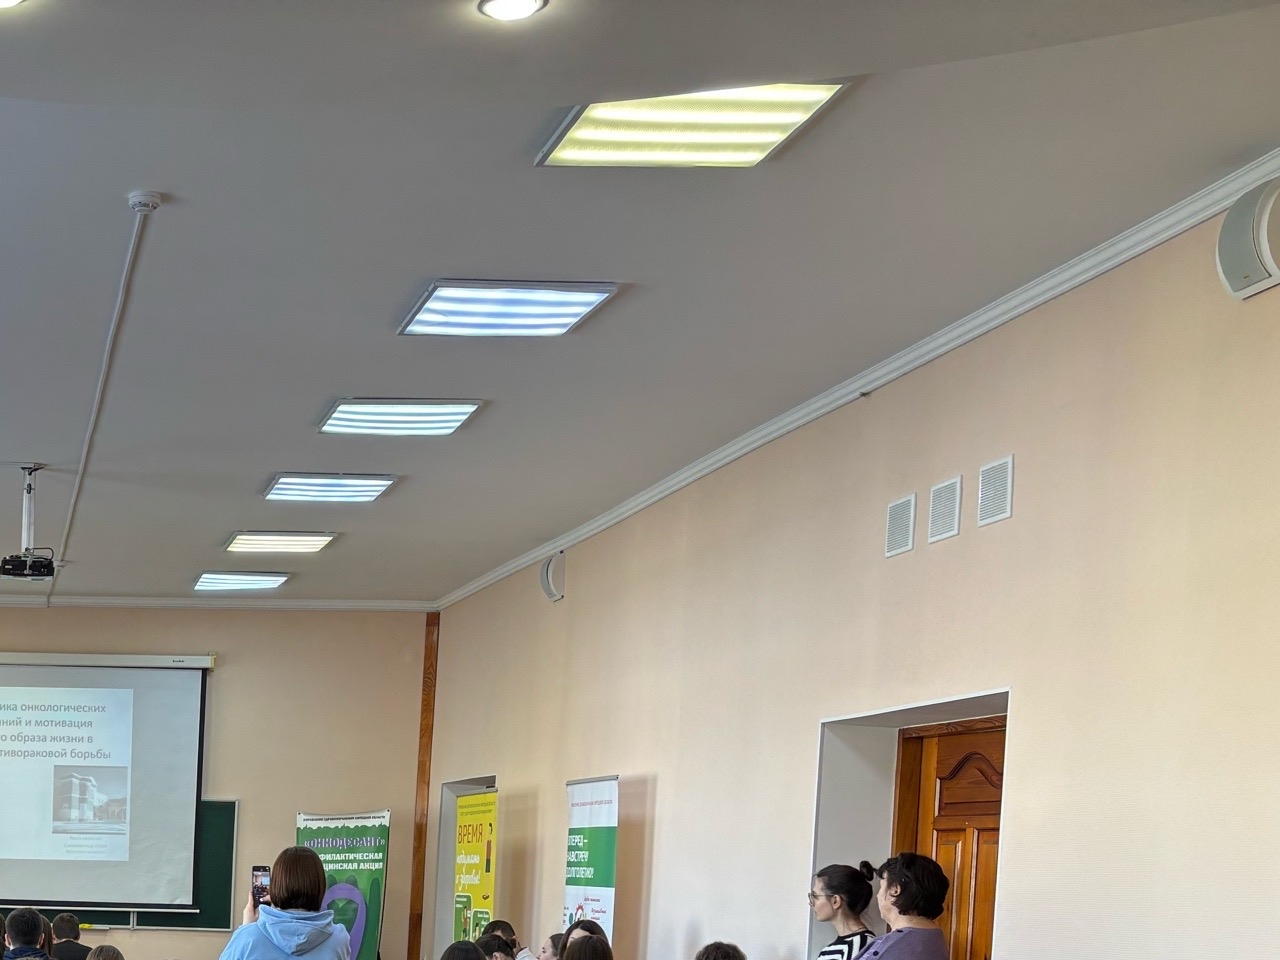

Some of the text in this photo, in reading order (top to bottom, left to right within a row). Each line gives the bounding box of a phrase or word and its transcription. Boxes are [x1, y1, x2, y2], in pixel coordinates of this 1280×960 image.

[20, 703, 106, 713] онкологических
[25, 719, 32, 727] и
[34, 719, 93, 729] мотивация
[10, 732, 47, 744] образа
[49, 735, 84, 744] жизни
[87, 735, 93, 744] в
[70, 749, 111, 760] борьбы
[458, 823, 483, 844] ВРЕМЯ
[320, 852, 382, 861] ФИЛАКТИЧЕСКАЯ
[323, 862, 383, 871] ЦИНСКАЯ АКЦИЯ
